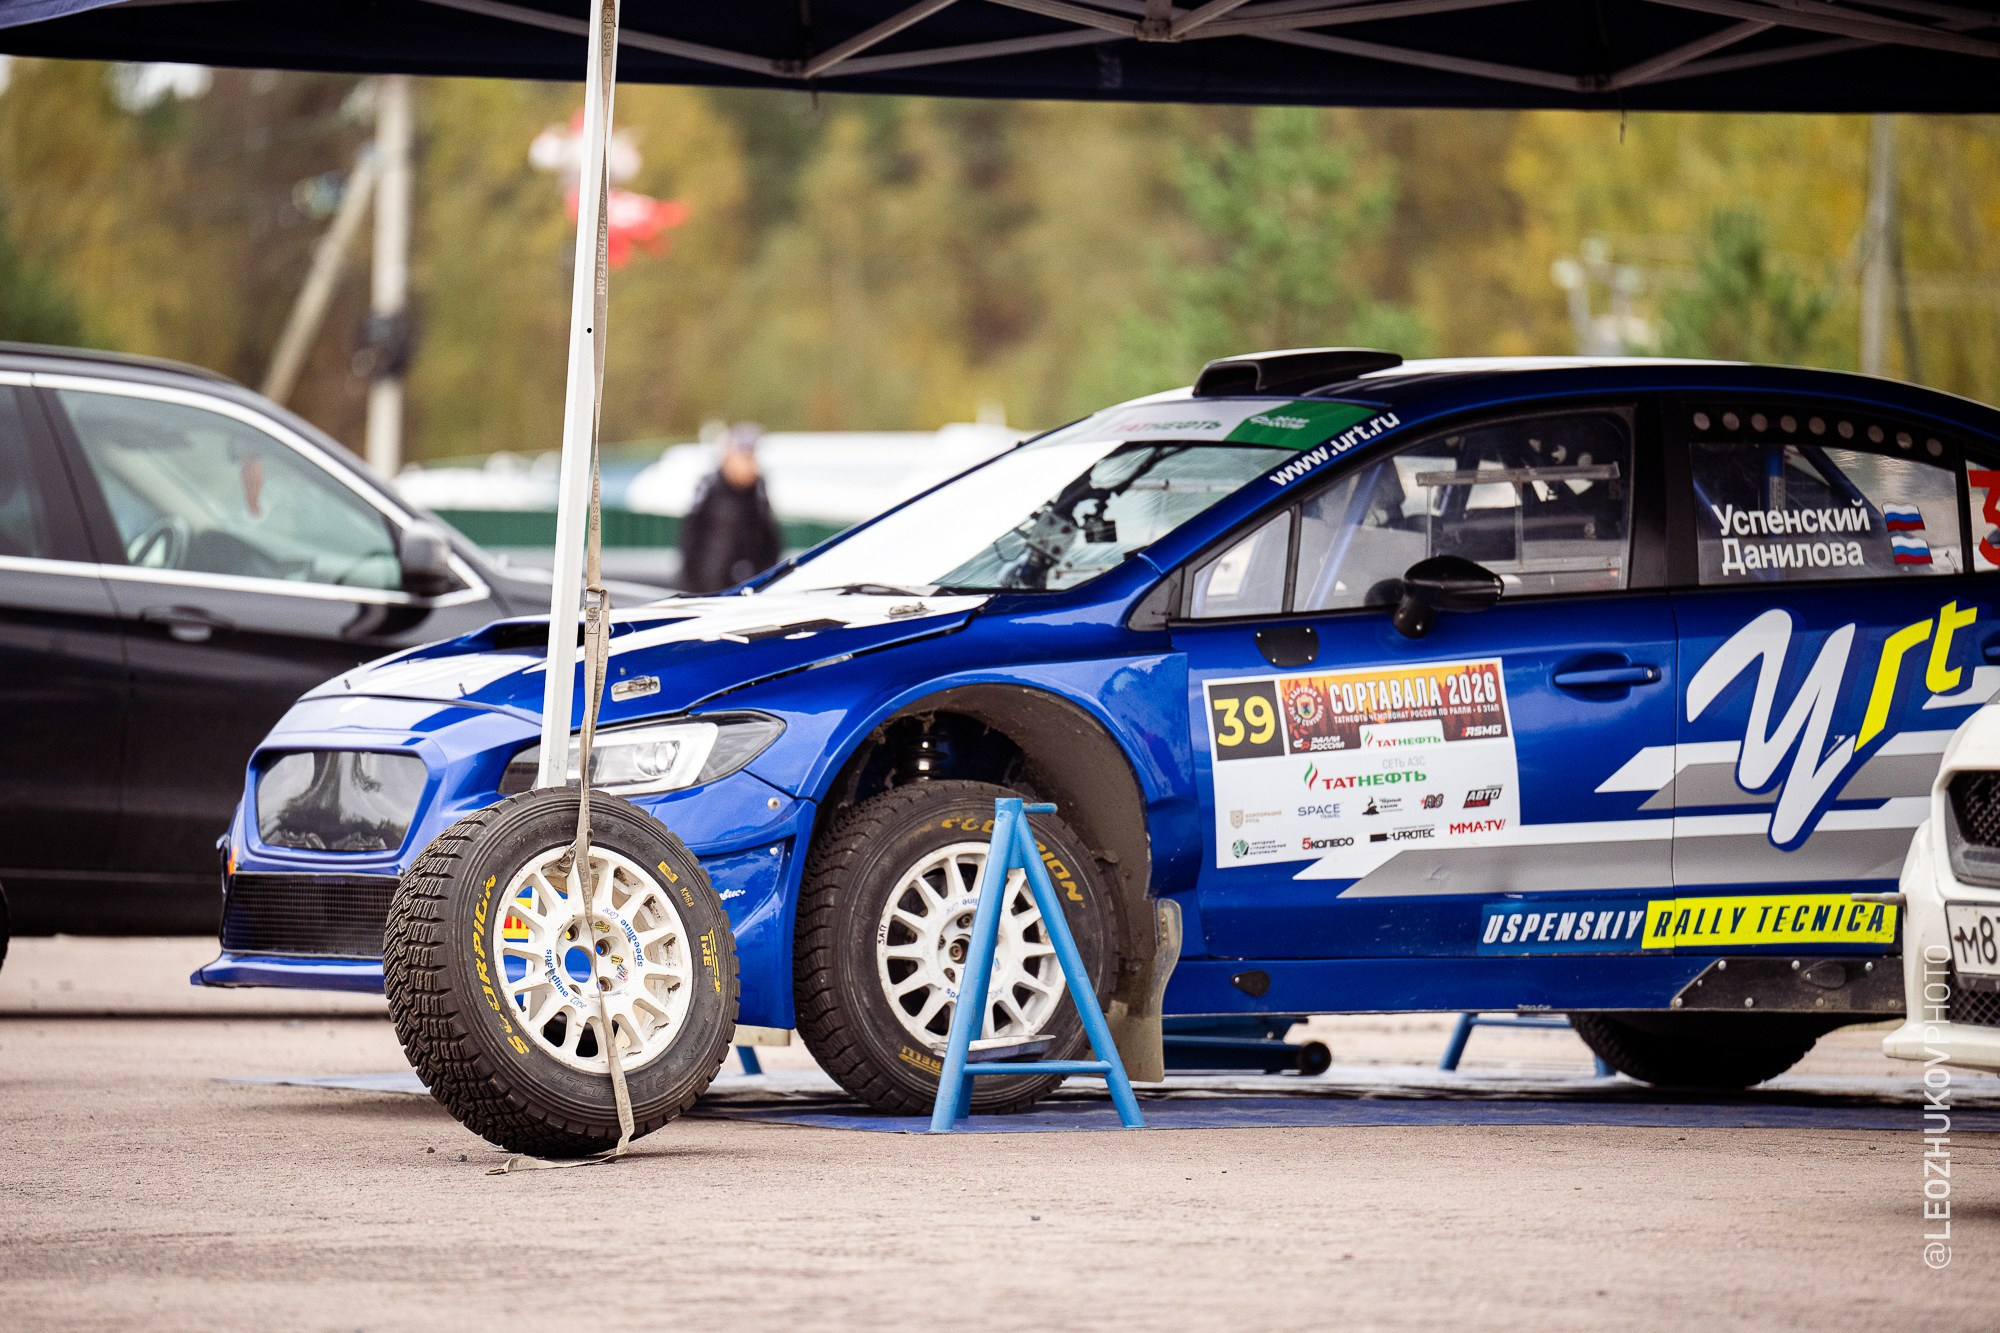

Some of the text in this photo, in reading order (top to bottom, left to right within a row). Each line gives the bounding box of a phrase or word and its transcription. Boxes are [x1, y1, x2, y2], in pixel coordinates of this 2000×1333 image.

[1270, 412, 1401, 486] www.urt.ru
[1711, 498, 1871, 536] Успенский
[1722, 538, 1865, 576] Данилова
[1329, 671, 1498, 714] СОРТАВАЛА 2026
[1213, 695, 1276, 747] 39
[1377, 735, 1442, 748] ТАТНЕФТЬ
[1321, 771, 1427, 790] ТАТНЕФТЬ
[1382, 755, 1427, 770] СЕТЬ АЗС
[1298, 803, 1341, 817] SPACE
[1466, 789, 1501, 800] АВТО
[1482, 909, 1646, 944] USPENSKIY
[1652, 903, 1887, 938] RALLY TECNICA
[620, 919, 644, 967] speedline
[1958, 915, 2000, 966] М8
